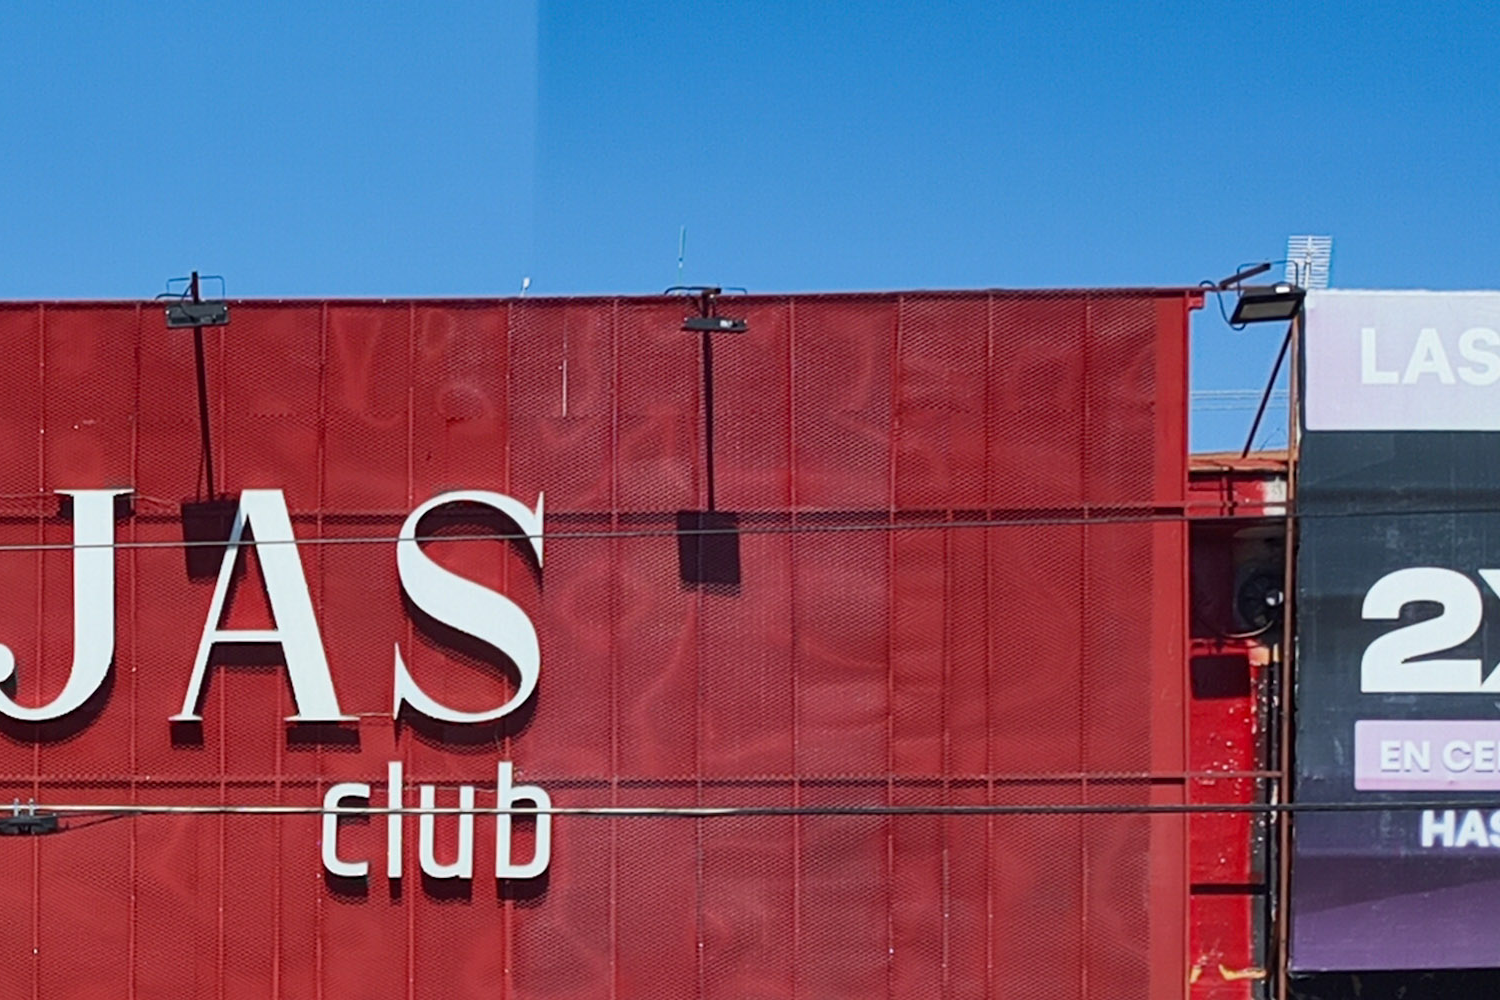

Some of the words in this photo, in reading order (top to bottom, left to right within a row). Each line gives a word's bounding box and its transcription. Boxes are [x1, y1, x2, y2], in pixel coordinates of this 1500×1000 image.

[1360, 566, 1500, 693] 2
[1380, 740, 1430, 773] EN
[1443, 739, 1500, 773] CE
[321, 761, 552, 879] club
